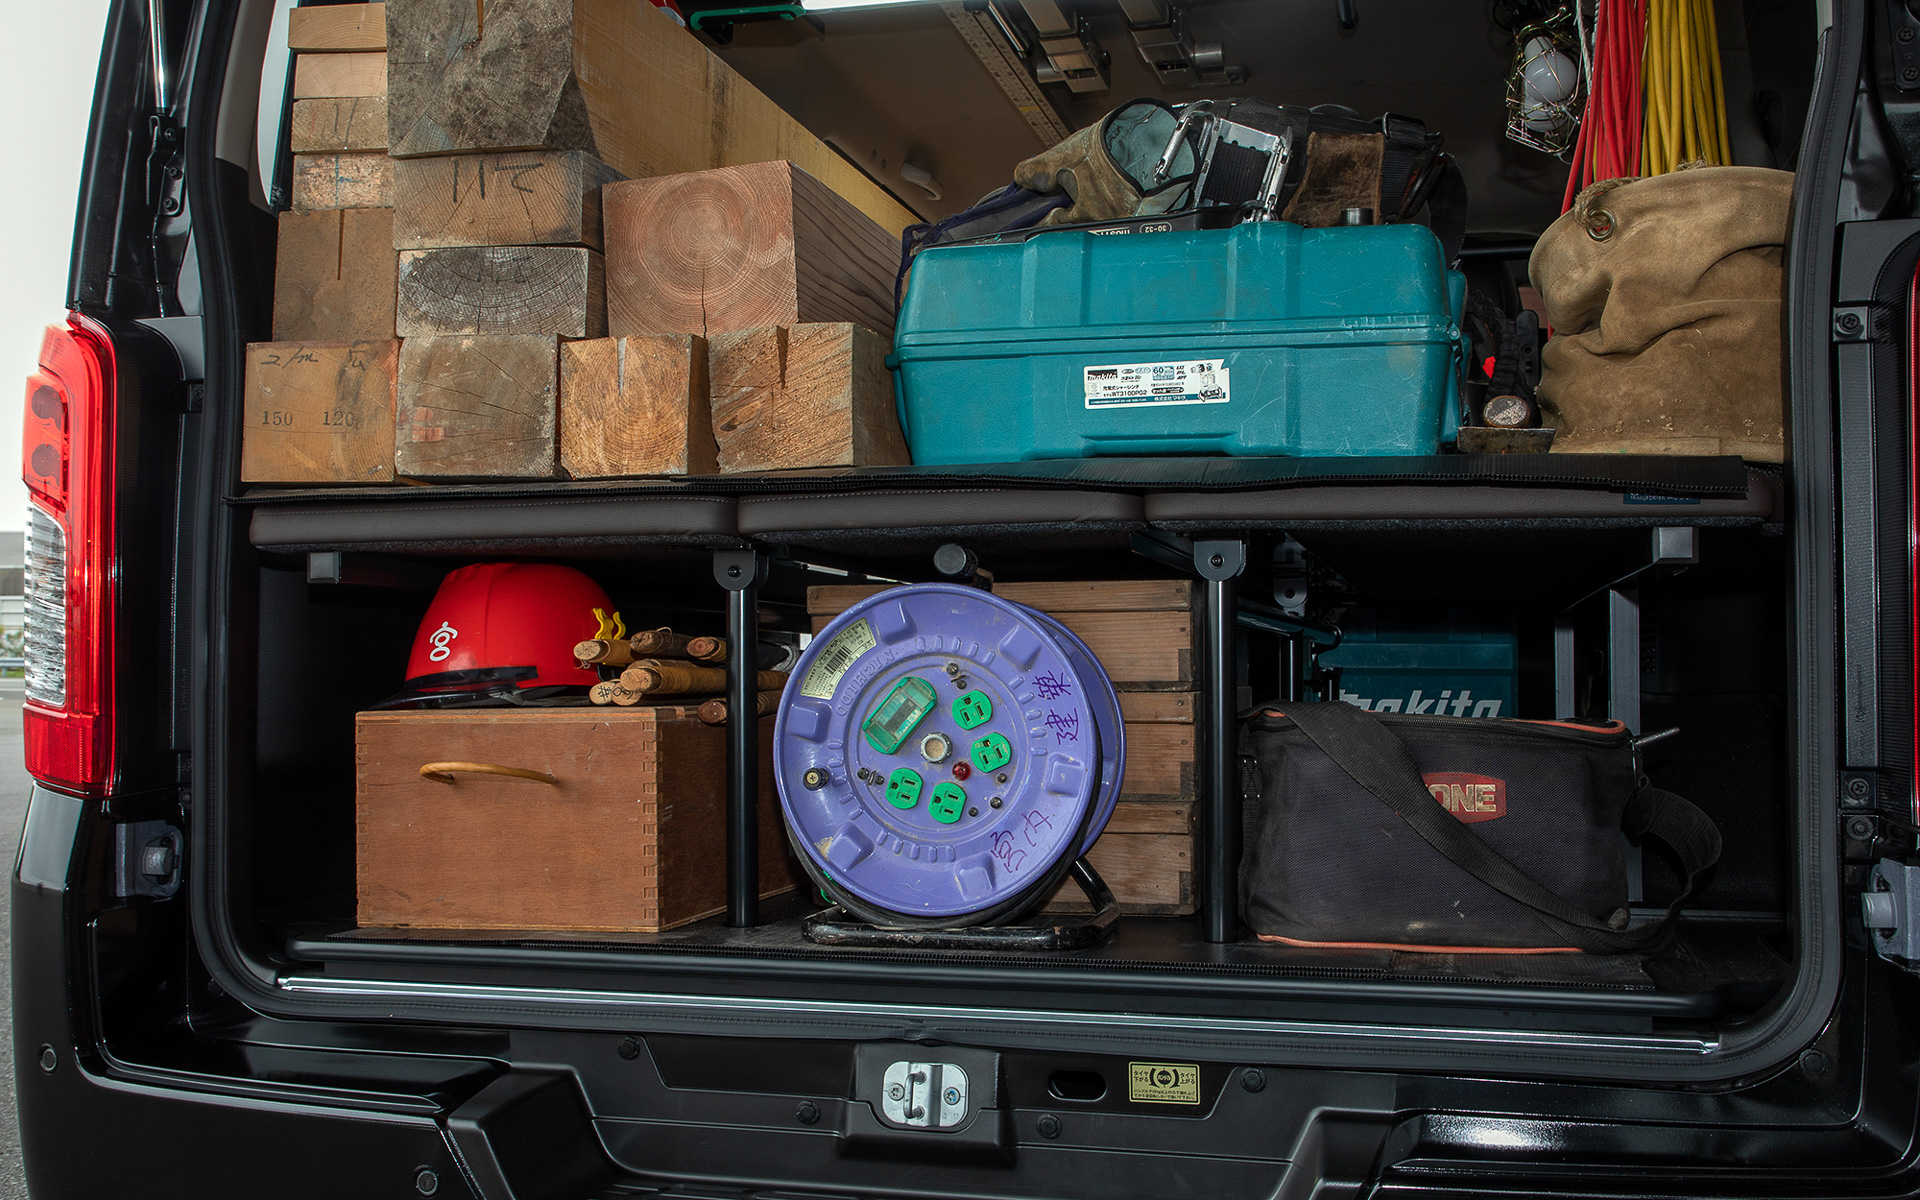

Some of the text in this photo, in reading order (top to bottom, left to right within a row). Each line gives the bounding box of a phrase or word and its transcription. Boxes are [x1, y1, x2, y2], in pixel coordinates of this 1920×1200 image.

[1144, 225, 1167, 234] 30-32
[1153, 366, 1164, 374] 60
[1088, 372, 1118, 381] makita
[262, 410, 354, 427] 150 120
[1425, 783, 1497, 812] ONE
